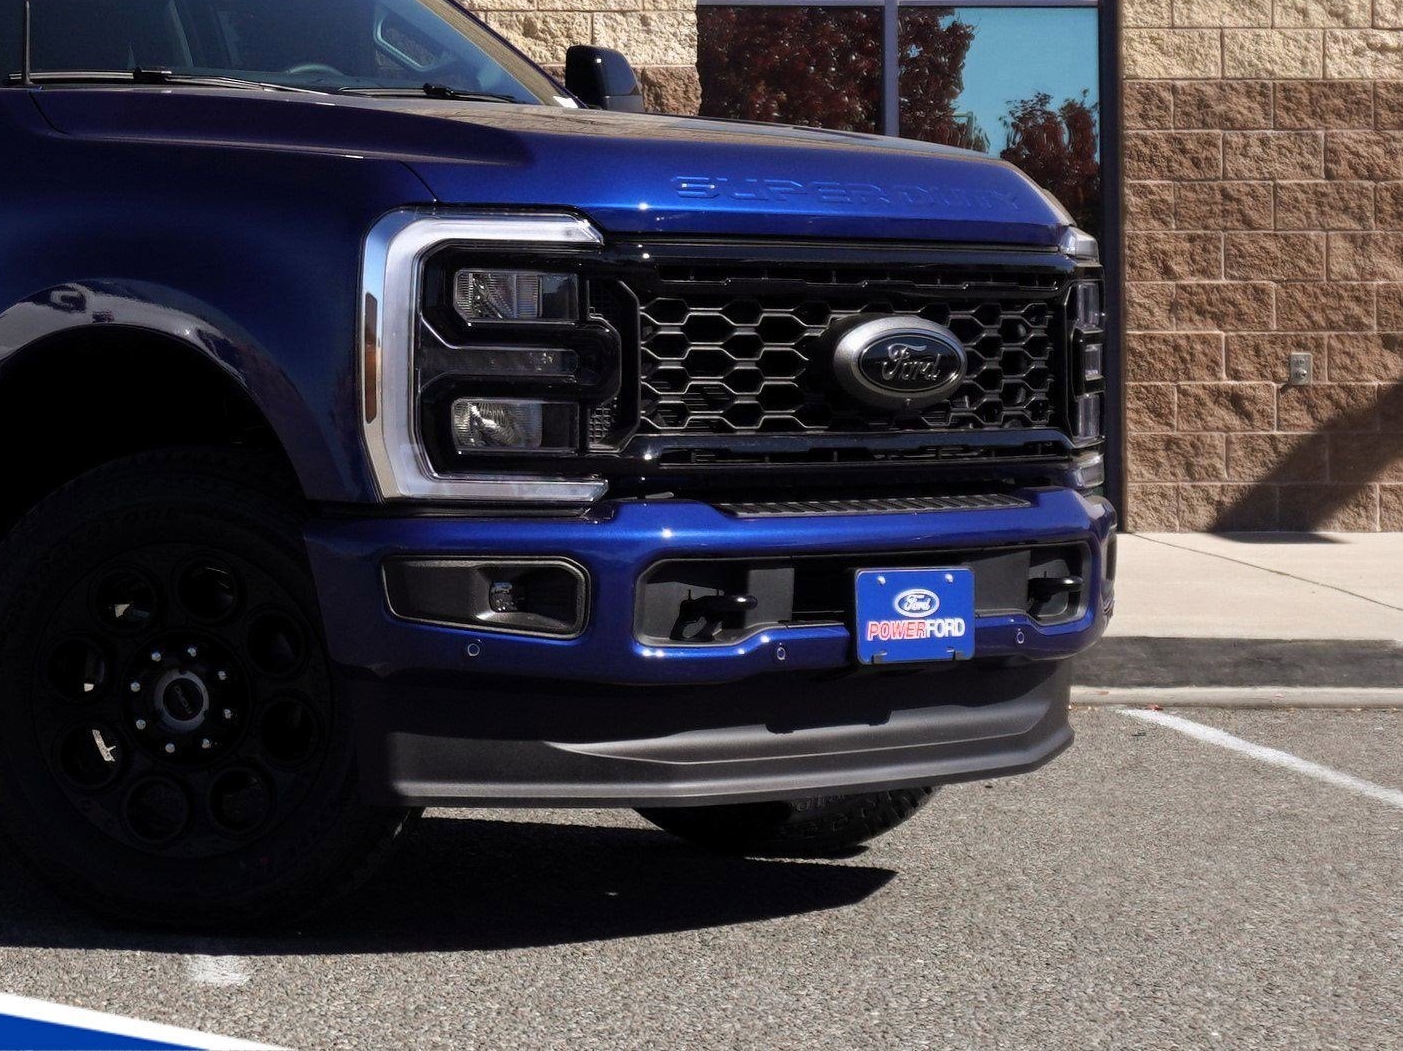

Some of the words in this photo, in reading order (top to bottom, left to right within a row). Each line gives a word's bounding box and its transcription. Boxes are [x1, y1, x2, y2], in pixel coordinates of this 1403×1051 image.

[881, 342, 941, 381] Ford
[903, 593, 932, 613] Ford
[866, 617, 966, 642] POWERFORD
